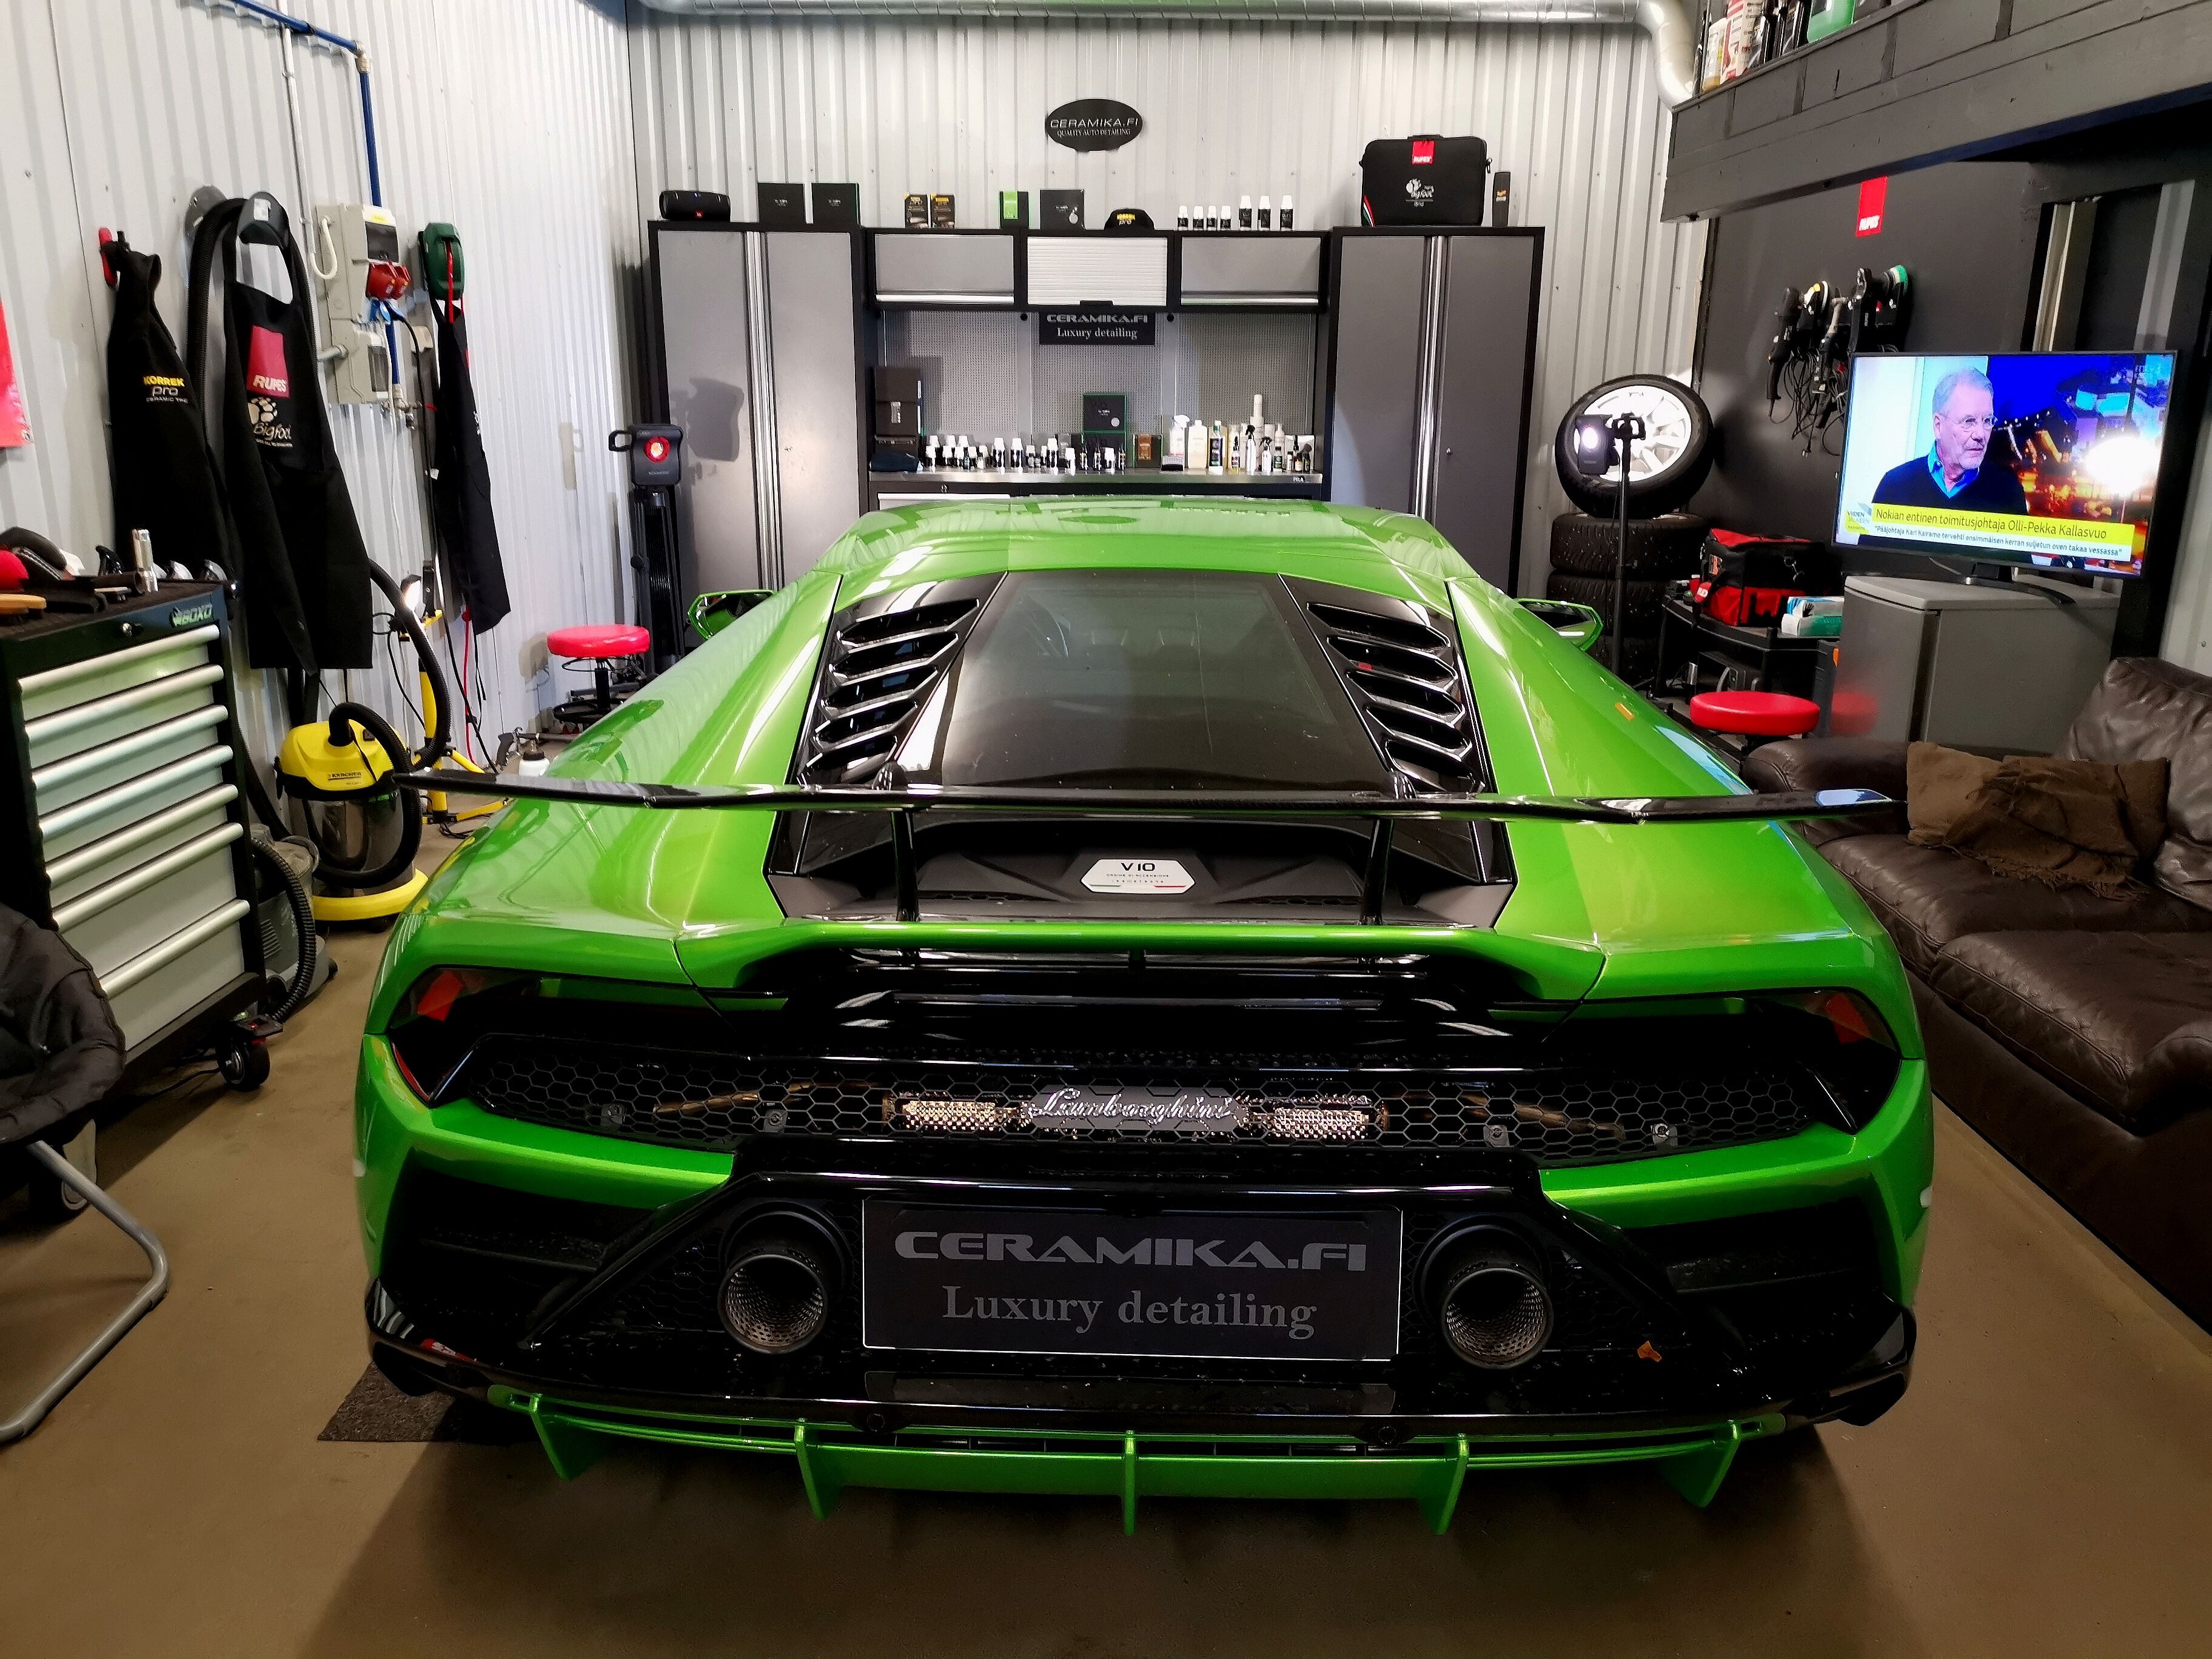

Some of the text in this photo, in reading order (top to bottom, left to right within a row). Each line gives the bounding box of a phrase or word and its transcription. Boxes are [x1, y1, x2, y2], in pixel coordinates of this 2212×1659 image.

[1050, 118, 1138, 129] CERAMIKA.FI
[1057, 127, 1131, 138] QUALITY AUTO DETAILING
[1047, 313, 1148, 323] CERAMIKA.FI
[1057, 326, 1138, 340] Luxury detailing
[143, 375, 185, 387] KORREK
[152, 385, 178, 397] pro
[1876, 509, 2106, 539] Nokian entinen toimitusjohtaja Olli-Pekka Kallasvuo
[1966, 535, 2003, 544] ensimmäisen
[2005, 538, 2025, 546] kerran
[895, 1231, 1367, 1272] CERAMIKA.FI
[942, 1285, 1318, 1341] Luxury detailing
